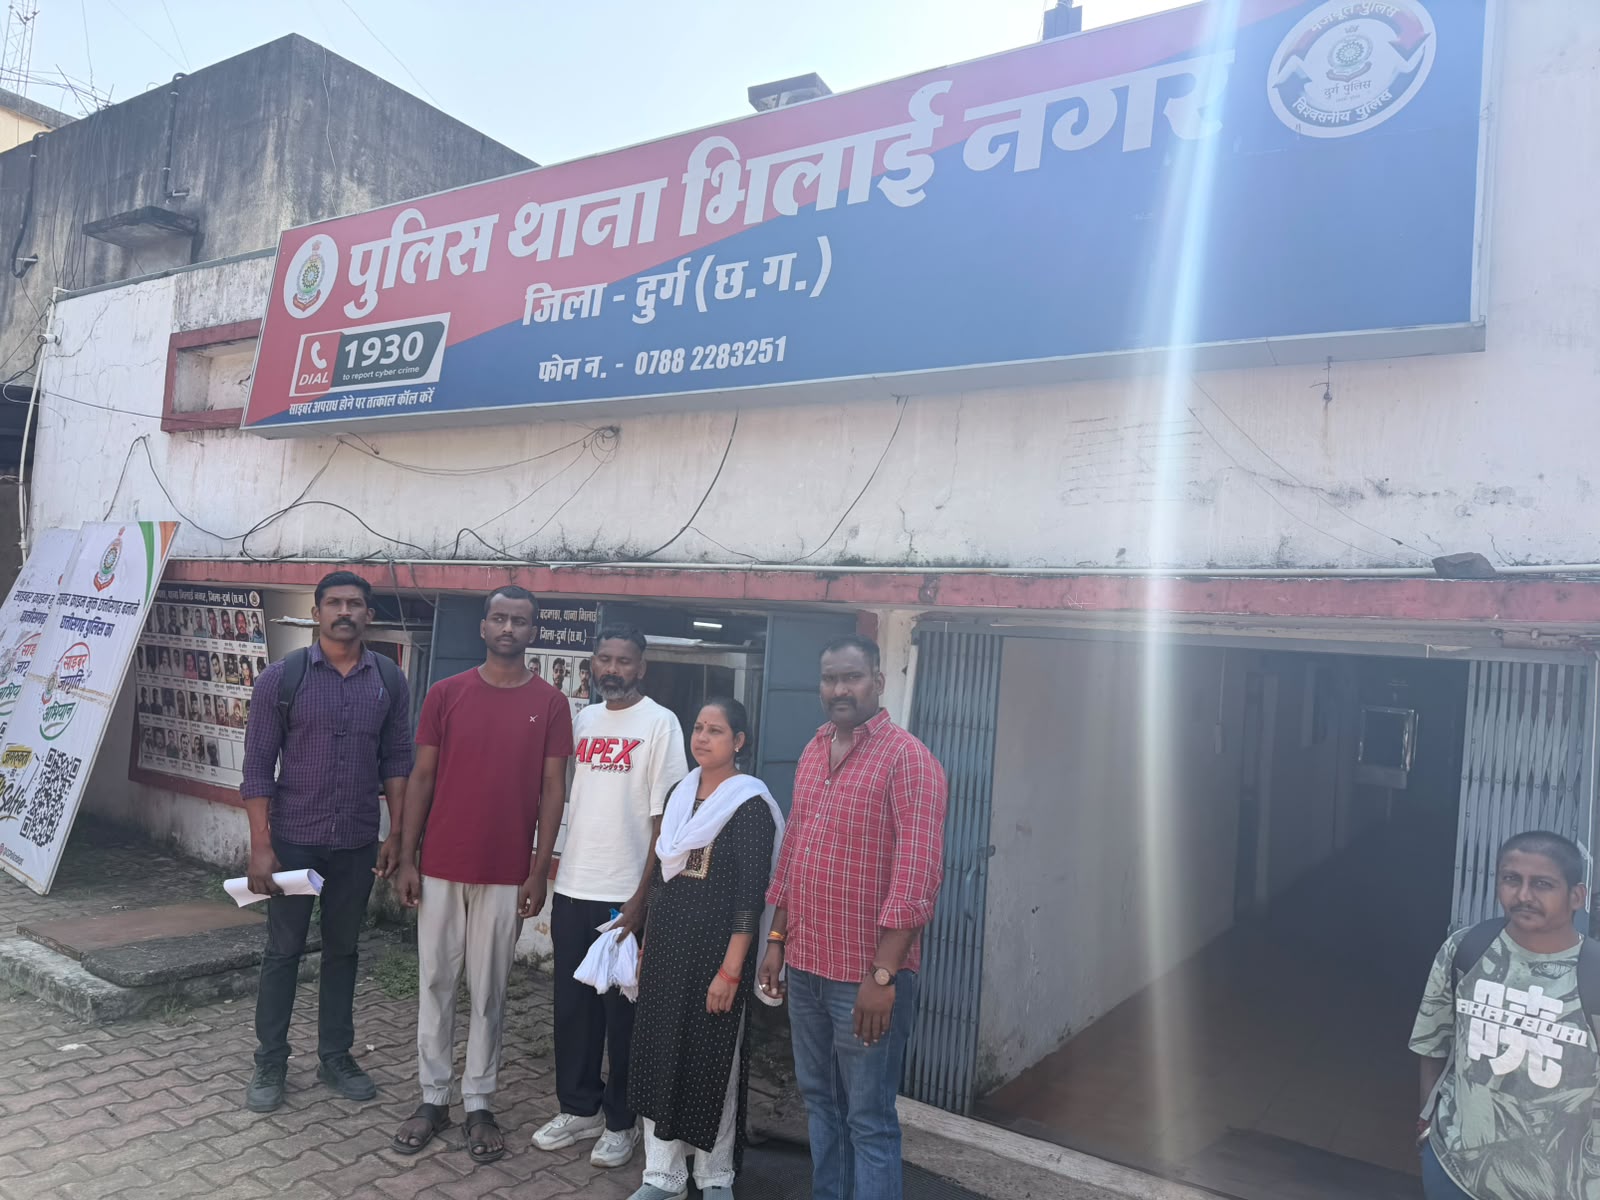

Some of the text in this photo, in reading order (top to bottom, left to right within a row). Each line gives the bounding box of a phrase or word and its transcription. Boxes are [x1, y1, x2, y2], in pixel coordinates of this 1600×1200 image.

[1343, 80, 1372, 96] पुलिस
[1292, 88, 1393, 124] विश्वसनीय पुलिस
[343, 48, 1236, 319] पुलिस थाना भिलाई नगर
[522, 282, 608, 325] जिला
[632, 257, 692, 324] दुर्ग
[344, 331, 424, 369] 1930
[538, 353, 581, 383] फोन
[584, 356, 607, 379] न.
[634, 348, 686, 376] 0788
[689, 335, 787, 371] 2283251
[298, 372, 329, 386] DIAL
[342, 366, 420, 381] to report cyber crime
[288, 386, 436, 416] साइबर अपराध होने पर तत्काल कॉल करें
[63, 654, 88, 672] साइबर
[575, 737, 642, 765] APEX
